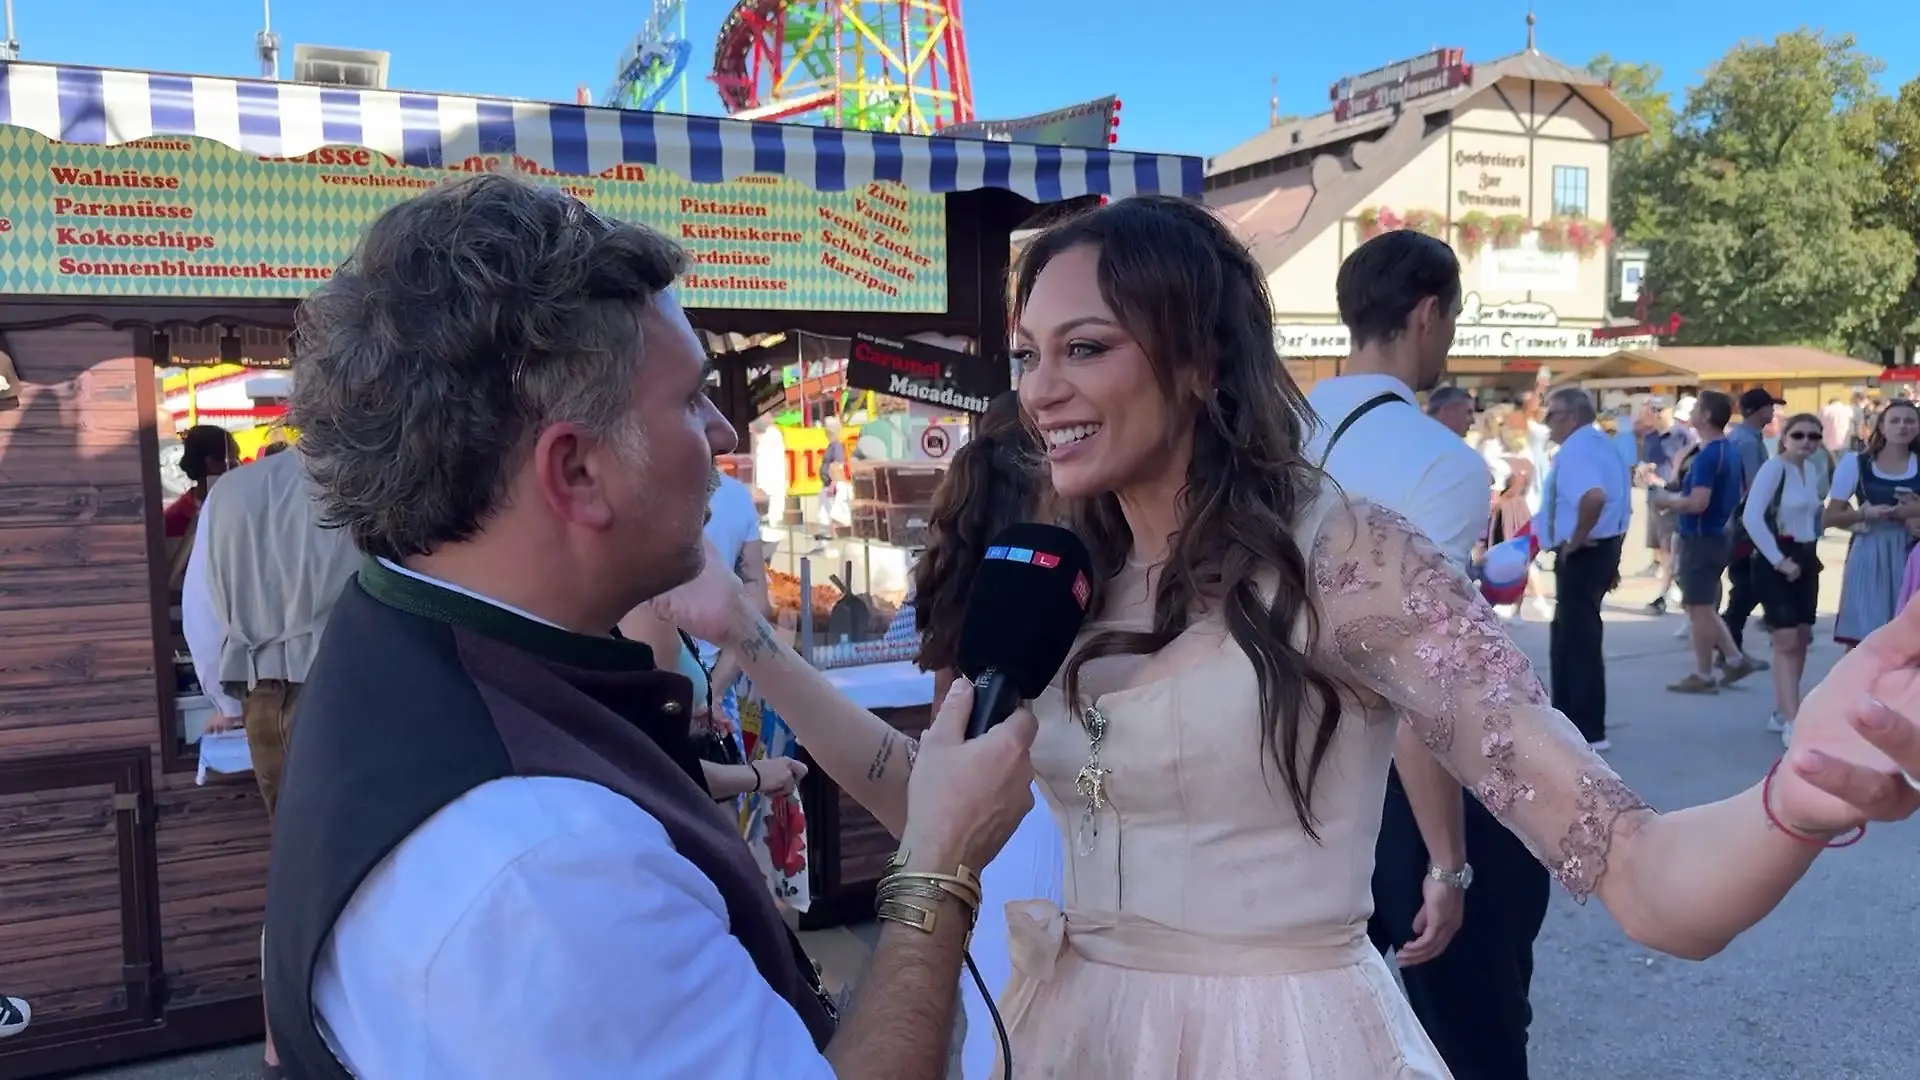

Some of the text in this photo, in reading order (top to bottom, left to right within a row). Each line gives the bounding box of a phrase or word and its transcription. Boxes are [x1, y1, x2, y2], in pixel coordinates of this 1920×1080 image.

[50, 167, 179, 190] Walnüsse
[321, 174, 436, 189] verschiedene
[53, 197, 193, 219] Paranüsse
[680, 197, 767, 217] Pistazien
[867, 183, 908, 213] Zimt
[855, 197, 911, 237] Vanille
[56, 227, 215, 251] Kokoschips
[681, 223, 802, 244] Kürbiskerne
[818, 206, 932, 268] wenig Zucker
[820, 229, 915, 283] Schokolade
[59, 258, 333, 280] Sonnenblumenkerne
[820, 252, 898, 298] Marzipan
[684, 275, 788, 291] Haselnüsse
[855, 342, 941, 378] Caramel
[889, 374, 990, 414] Macadami
